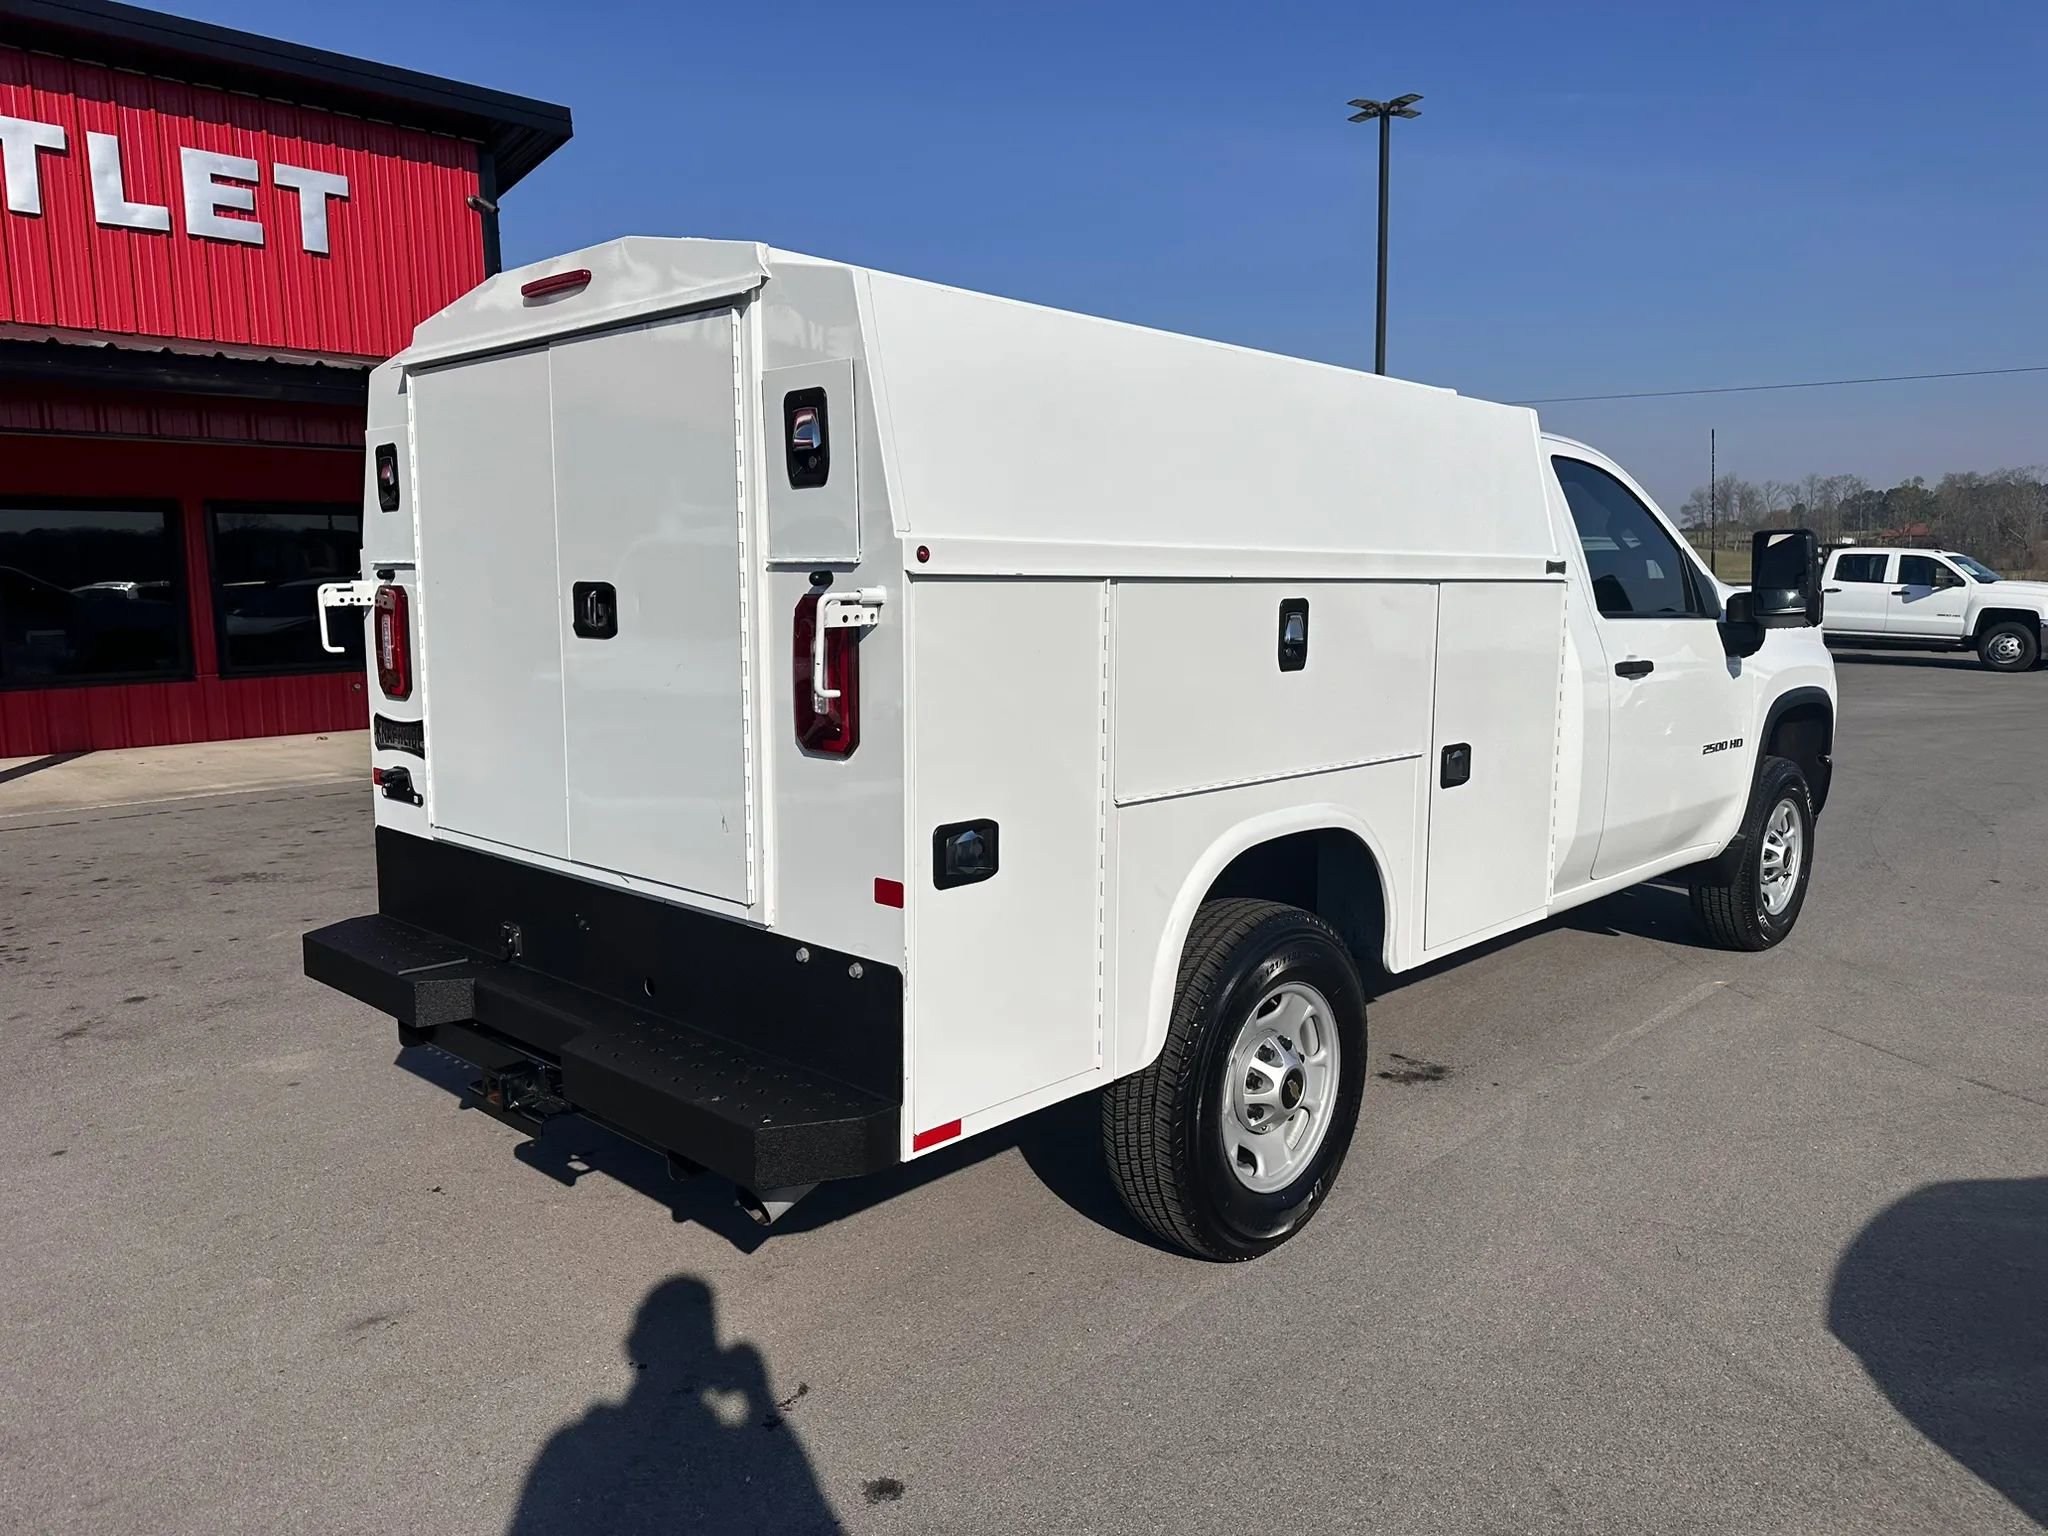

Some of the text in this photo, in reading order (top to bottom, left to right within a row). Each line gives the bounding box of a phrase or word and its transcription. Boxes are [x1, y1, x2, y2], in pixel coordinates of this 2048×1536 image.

[0, 115, 349, 254] TLET
[1702, 738, 1744, 755] 2500 HD
